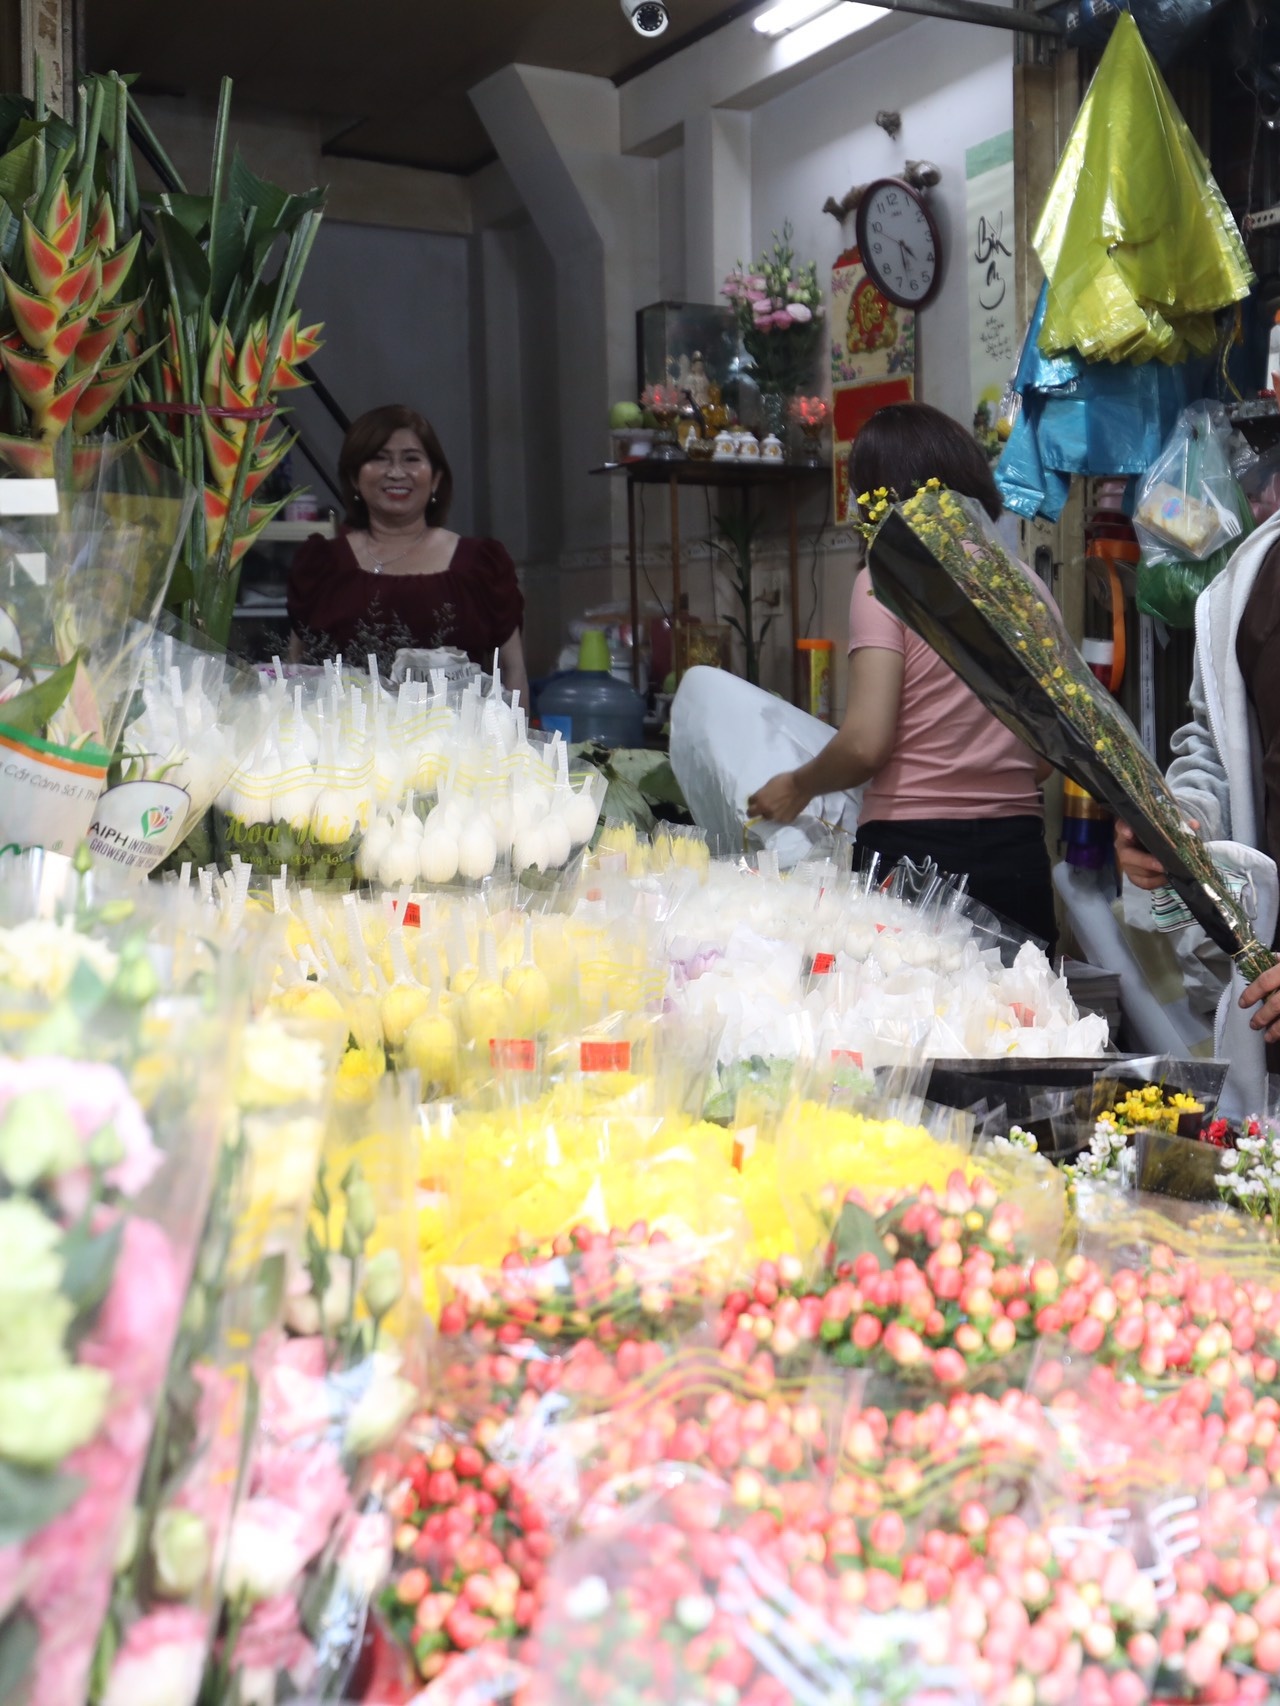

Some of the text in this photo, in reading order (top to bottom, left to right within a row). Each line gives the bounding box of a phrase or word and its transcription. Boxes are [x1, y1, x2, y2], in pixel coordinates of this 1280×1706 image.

[886, 192, 898, 205] 12
[877, 203, 886, 213] 11
[872, 221, 883, 234] 10
[873, 242, 882, 254] 9
[927, 252, 935, 263] 4
[883, 263, 892, 274] 8
[895, 276, 903, 288] 7
[921, 271, 931, 283] 5
[910, 280, 919, 291] 6
[90, 821, 129, 846] AIPH
[225, 810, 281, 845] Hoa
[89, 838, 127, 863] GROWER
